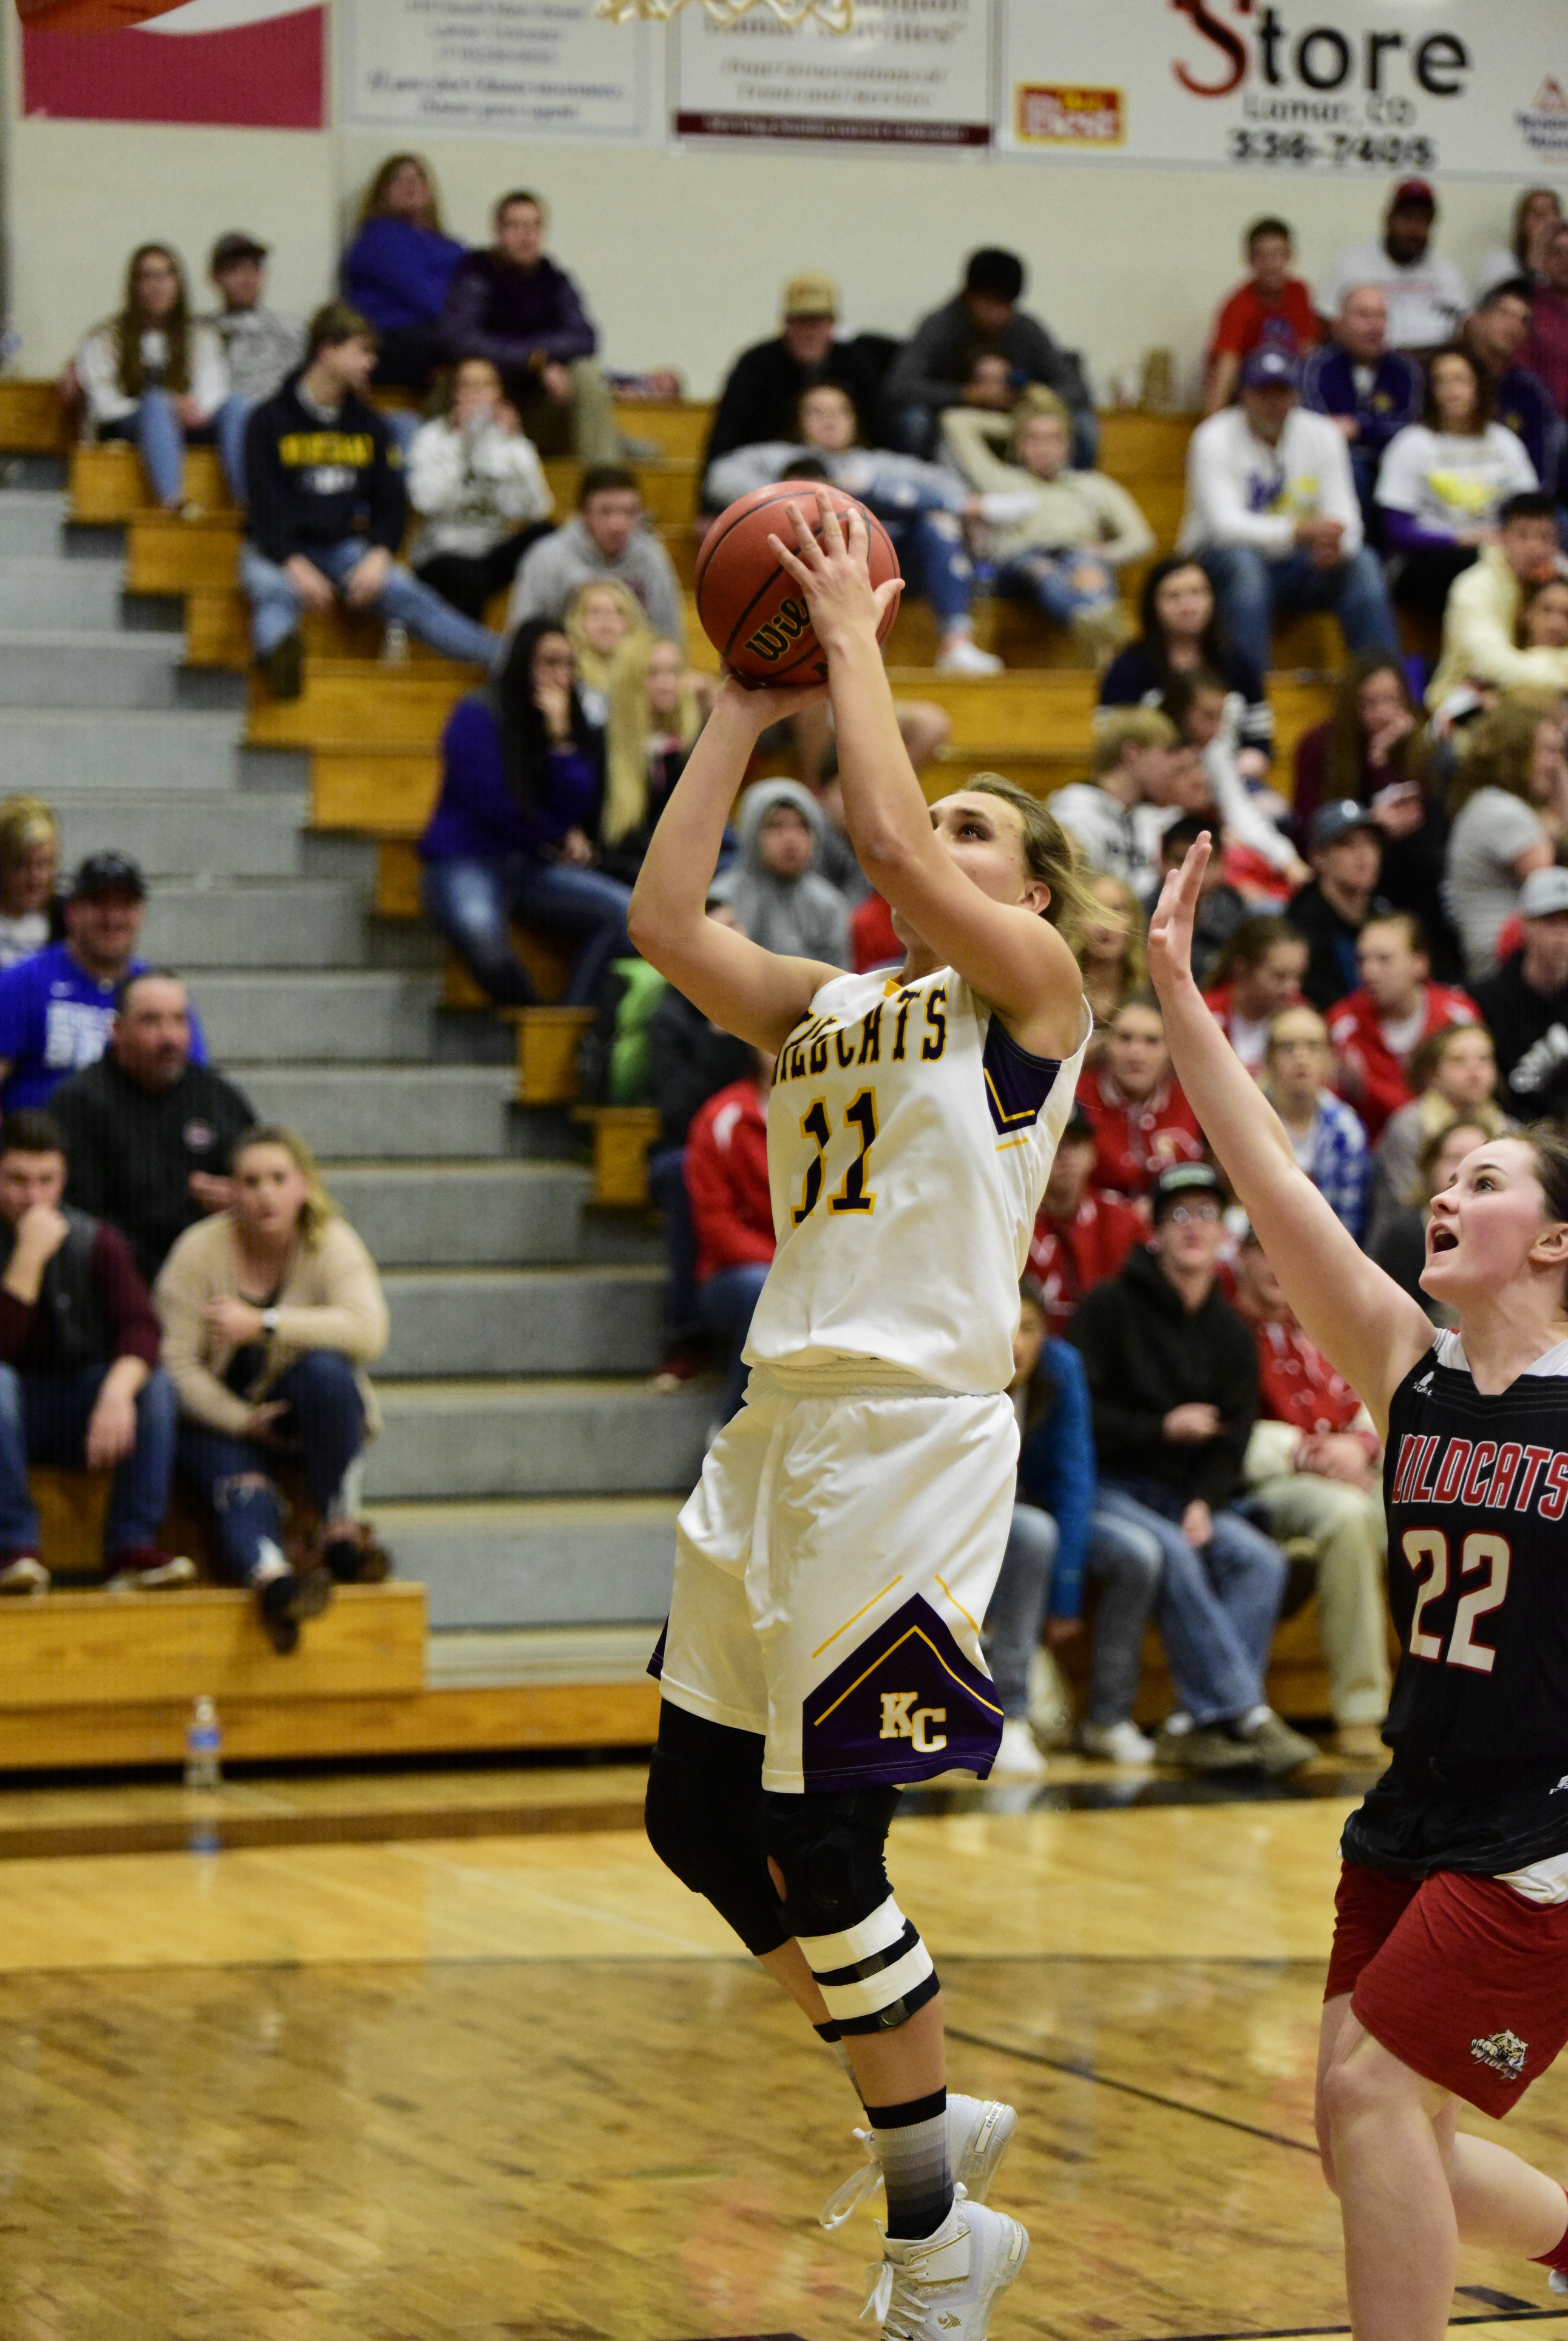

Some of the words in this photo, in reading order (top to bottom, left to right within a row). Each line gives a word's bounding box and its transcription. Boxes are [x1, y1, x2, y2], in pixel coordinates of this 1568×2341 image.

[1172, 0, 1468, 97] Store
[790, 1086, 879, 1229] 11
[1402, 1526, 1513, 1676] 22
[879, 1691, 947, 1753] KC
